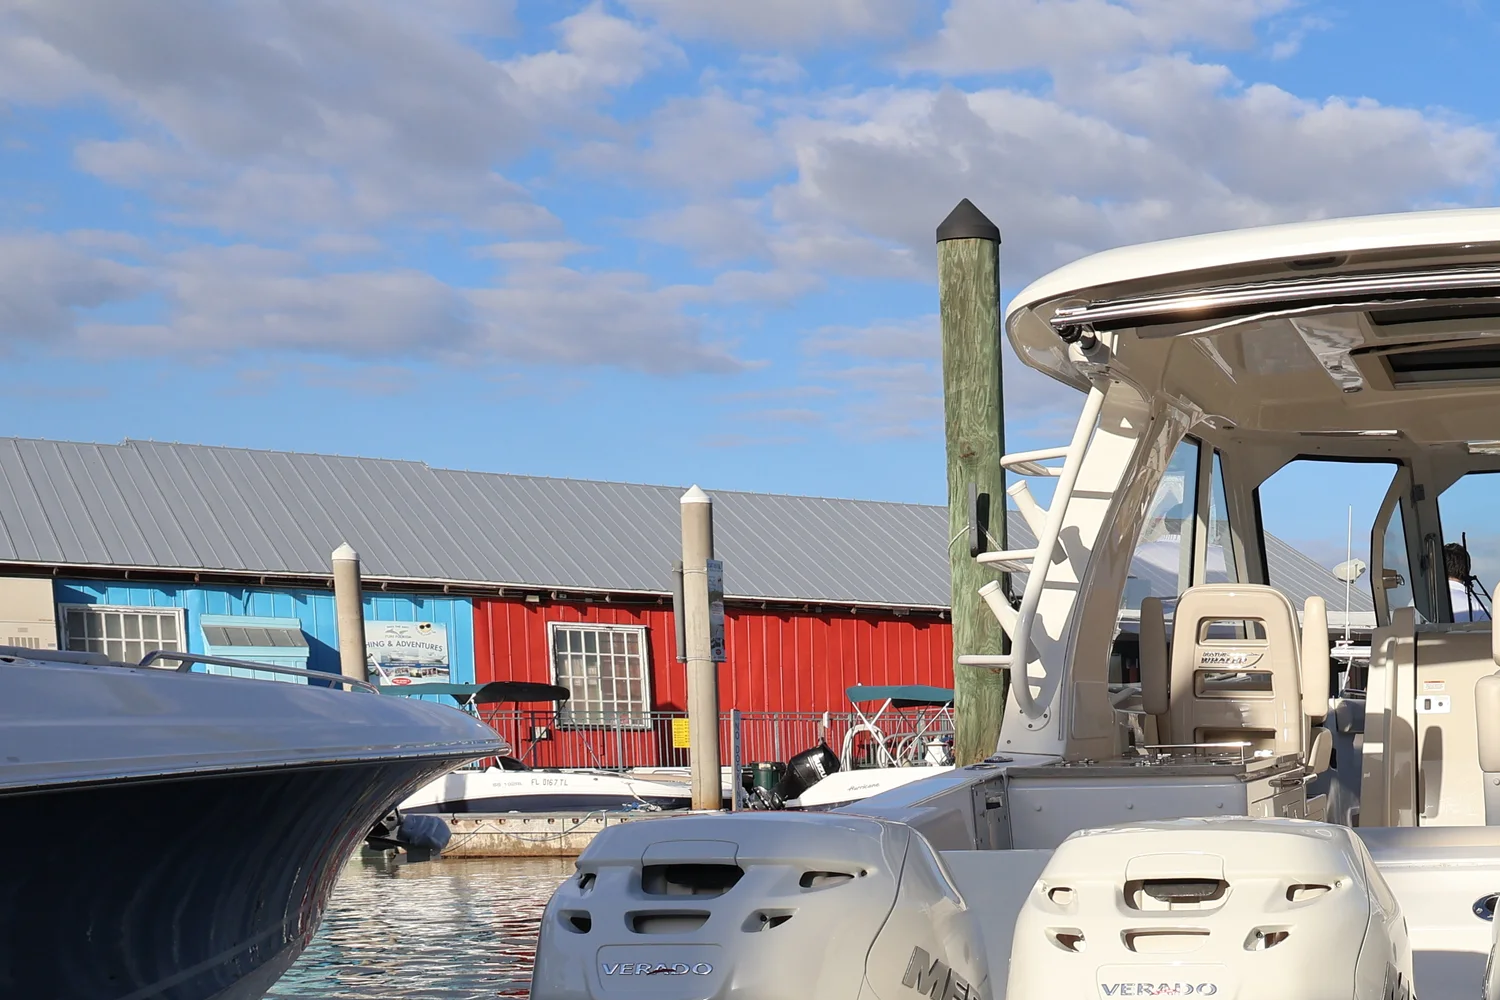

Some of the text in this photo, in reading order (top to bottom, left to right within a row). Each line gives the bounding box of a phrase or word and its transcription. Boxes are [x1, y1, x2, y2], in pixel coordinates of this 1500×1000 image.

[396, 641, 443, 652] ADVENTURES
[531, 778, 540, 786] FL
[847, 783, 880, 791] Hurricane
[601, 961, 714, 977] VERADO
[1100, 982, 1219, 996] VERADO
